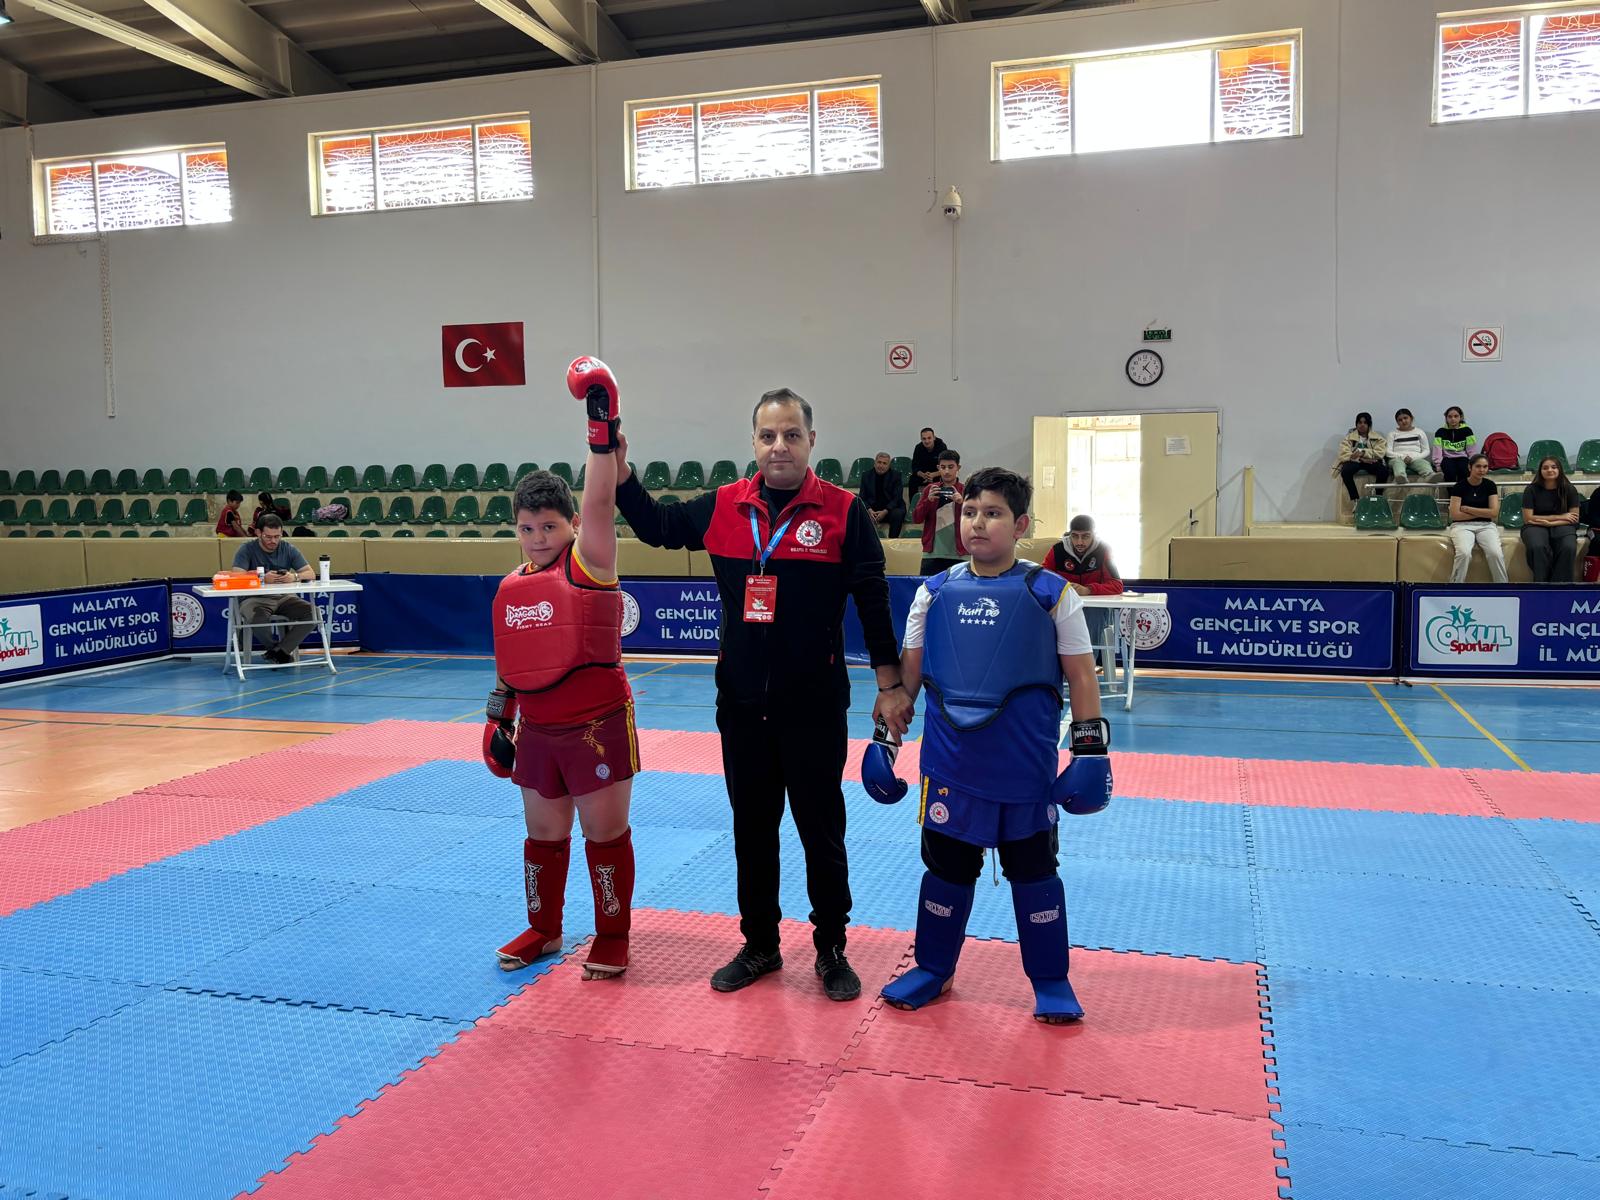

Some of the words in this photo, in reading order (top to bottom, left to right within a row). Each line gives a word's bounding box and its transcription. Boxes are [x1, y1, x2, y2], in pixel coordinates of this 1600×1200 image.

[72, 596, 137, 614] MALATYA
[680, 590, 721, 602] MALA
[1224, 597, 1325, 612] MALATYA
[506, 604, 539, 624] DRAGON
[655, 606, 717, 622] GENÇLİK
[49, 616, 107, 637] GENÇLİK
[109, 615, 125, 628] VE
[128, 611, 160, 626] SPOR
[661, 625, 674, 639] İL
[1189, 616, 1274, 635] GENÇLİK
[1277, 620, 1302, 633] VE
[1308, 620, 1361, 635] SPOR
[1531, 622, 1600, 640] GENÇL
[0, 630, 38, 651] KUL
[55, 642, 68, 658] İL
[73, 629, 158, 655] MÜDÜRLÜĞÜ
[1437, 624, 1512, 646] OKUL
[0, 646, 30, 661] porları
[1197, 637, 1213, 655] İL
[1221, 639, 1353, 659] MÜDÜRLÜĞÜ
[1450, 640, 1499, 655] Sporları
[1539, 644, 1557, 662] İL
